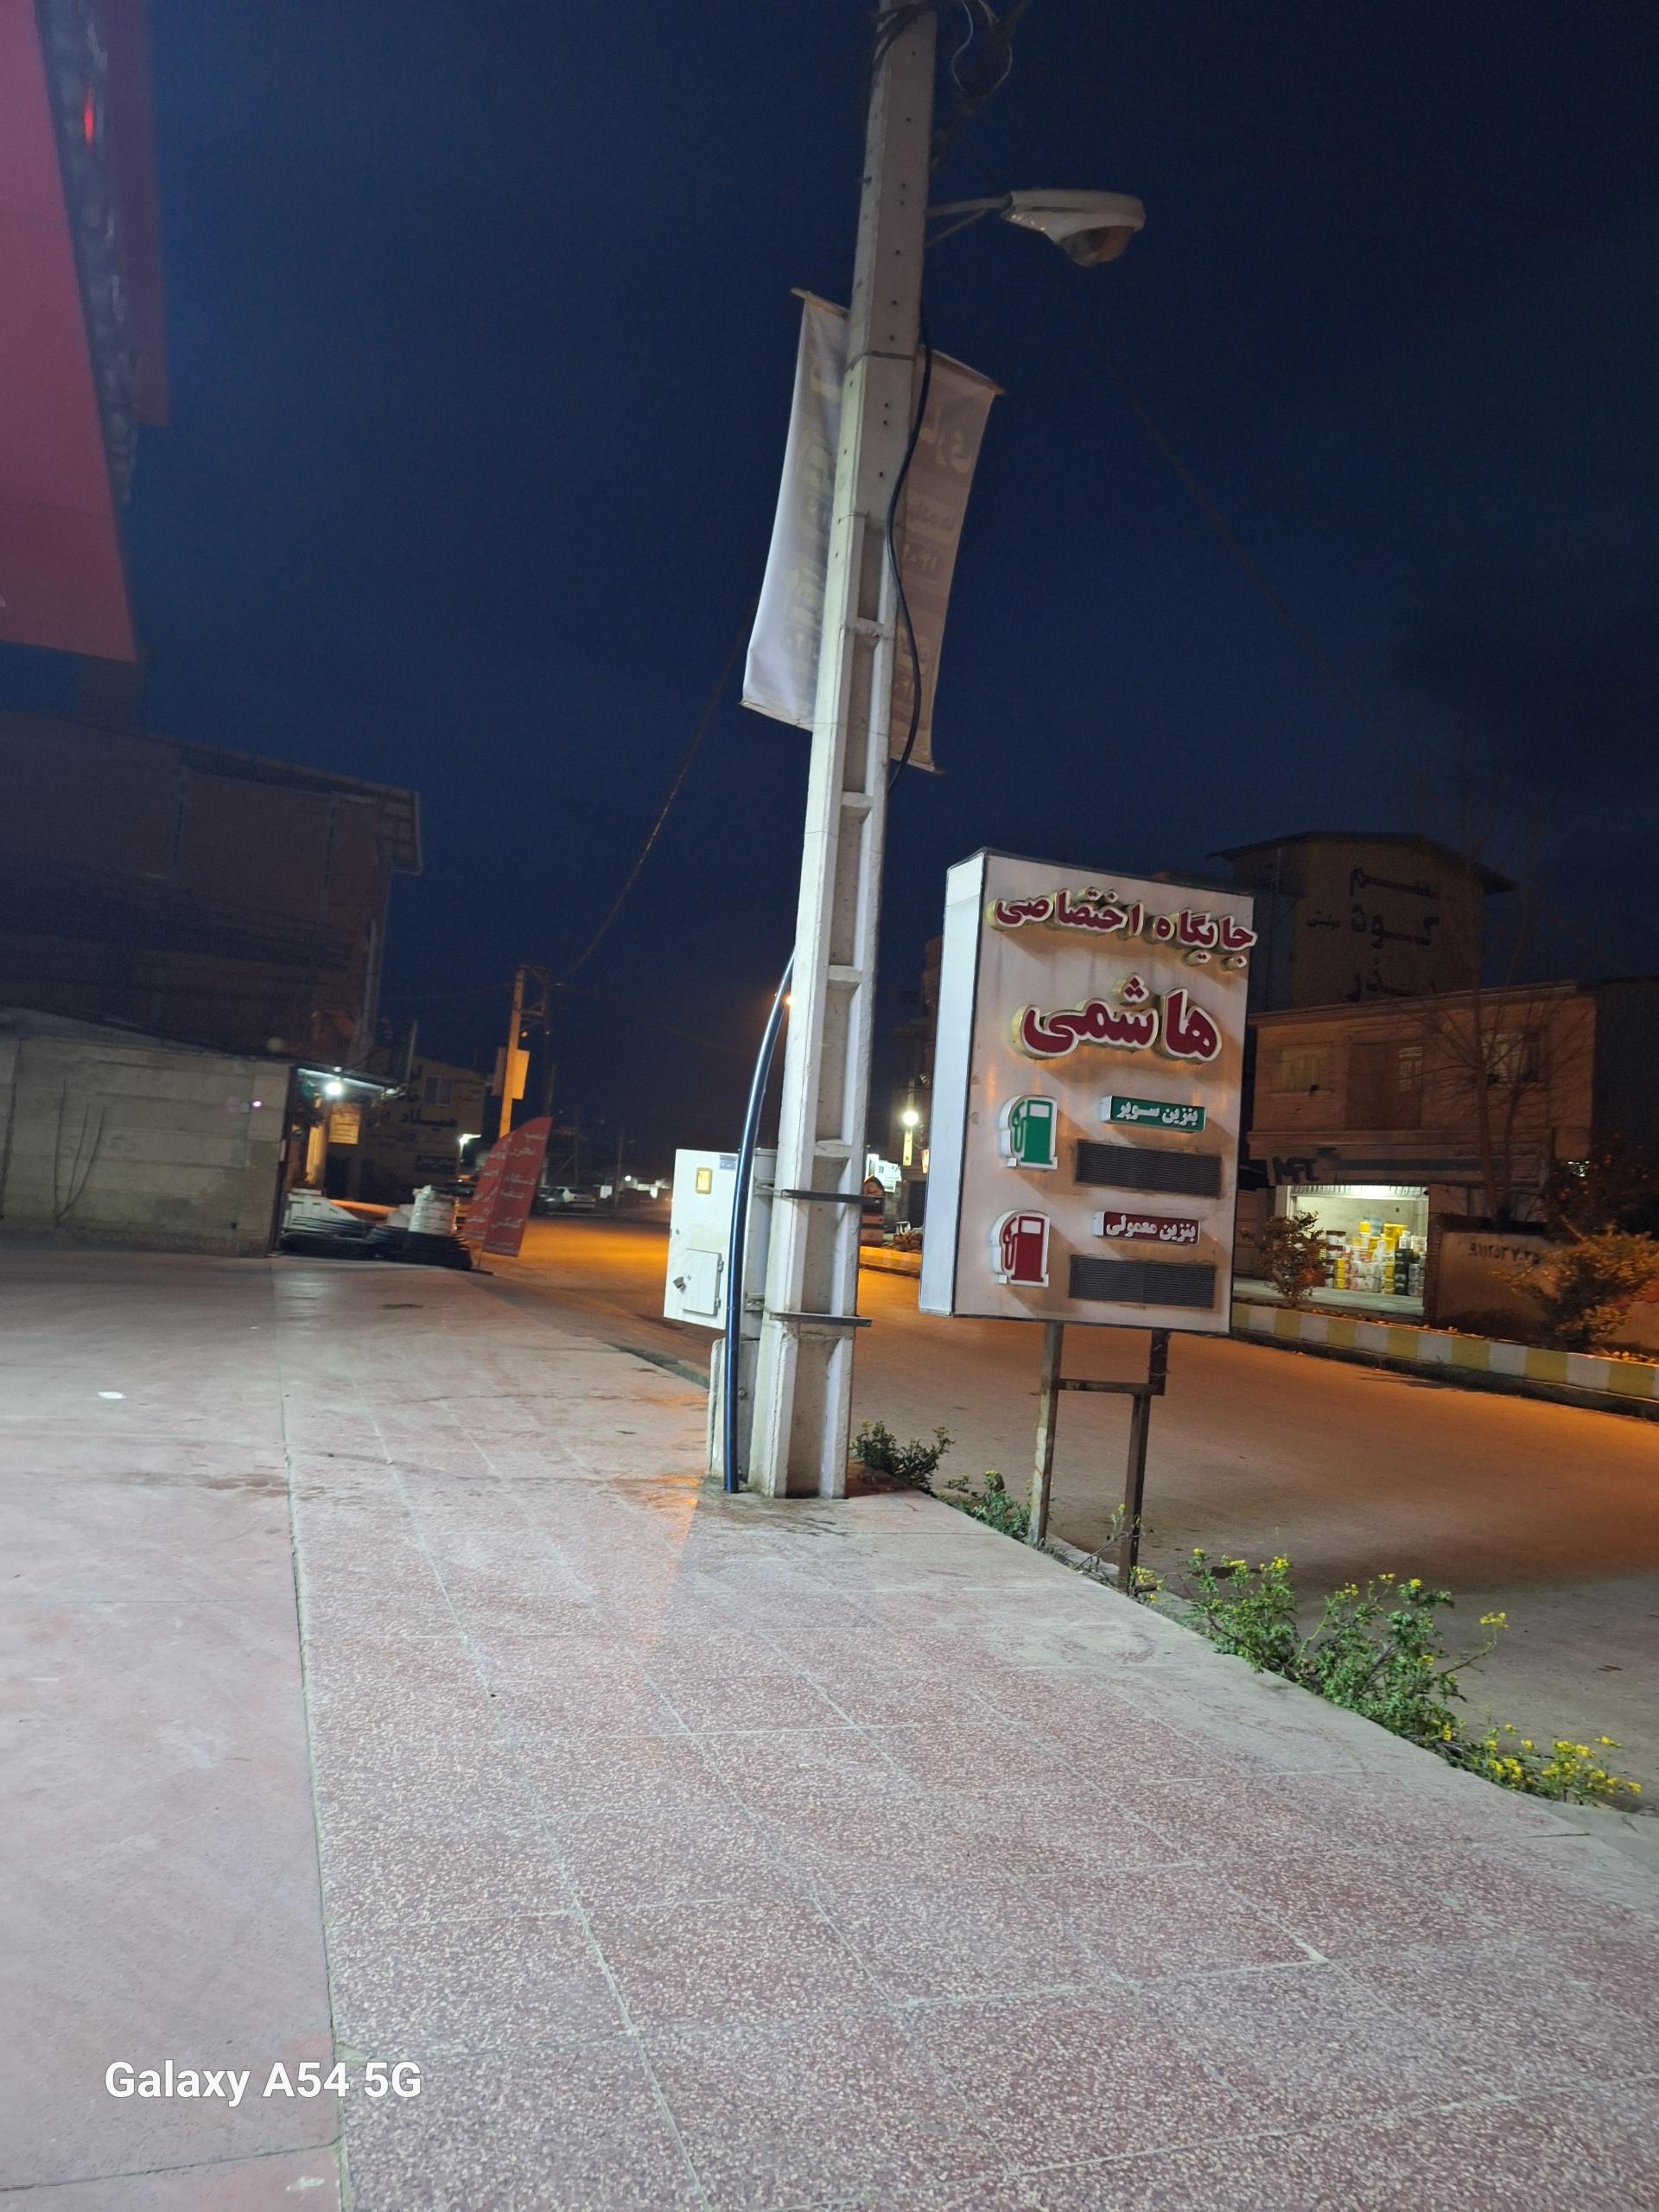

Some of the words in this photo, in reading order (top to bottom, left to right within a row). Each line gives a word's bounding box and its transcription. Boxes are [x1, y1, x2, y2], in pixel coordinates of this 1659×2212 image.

[991, 887, 1144, 937] اختصاصی
[1153, 909, 1258, 969] جایگاه
[1019, 972, 1223, 1062] هاشمی
[1116, 1101, 1160, 1121] سوپر
[1161, 1107, 1198, 1127] بنزین
[1106, 1214, 1158, 1238] معمولی
[1160, 1223, 1197, 1243] بنزین
